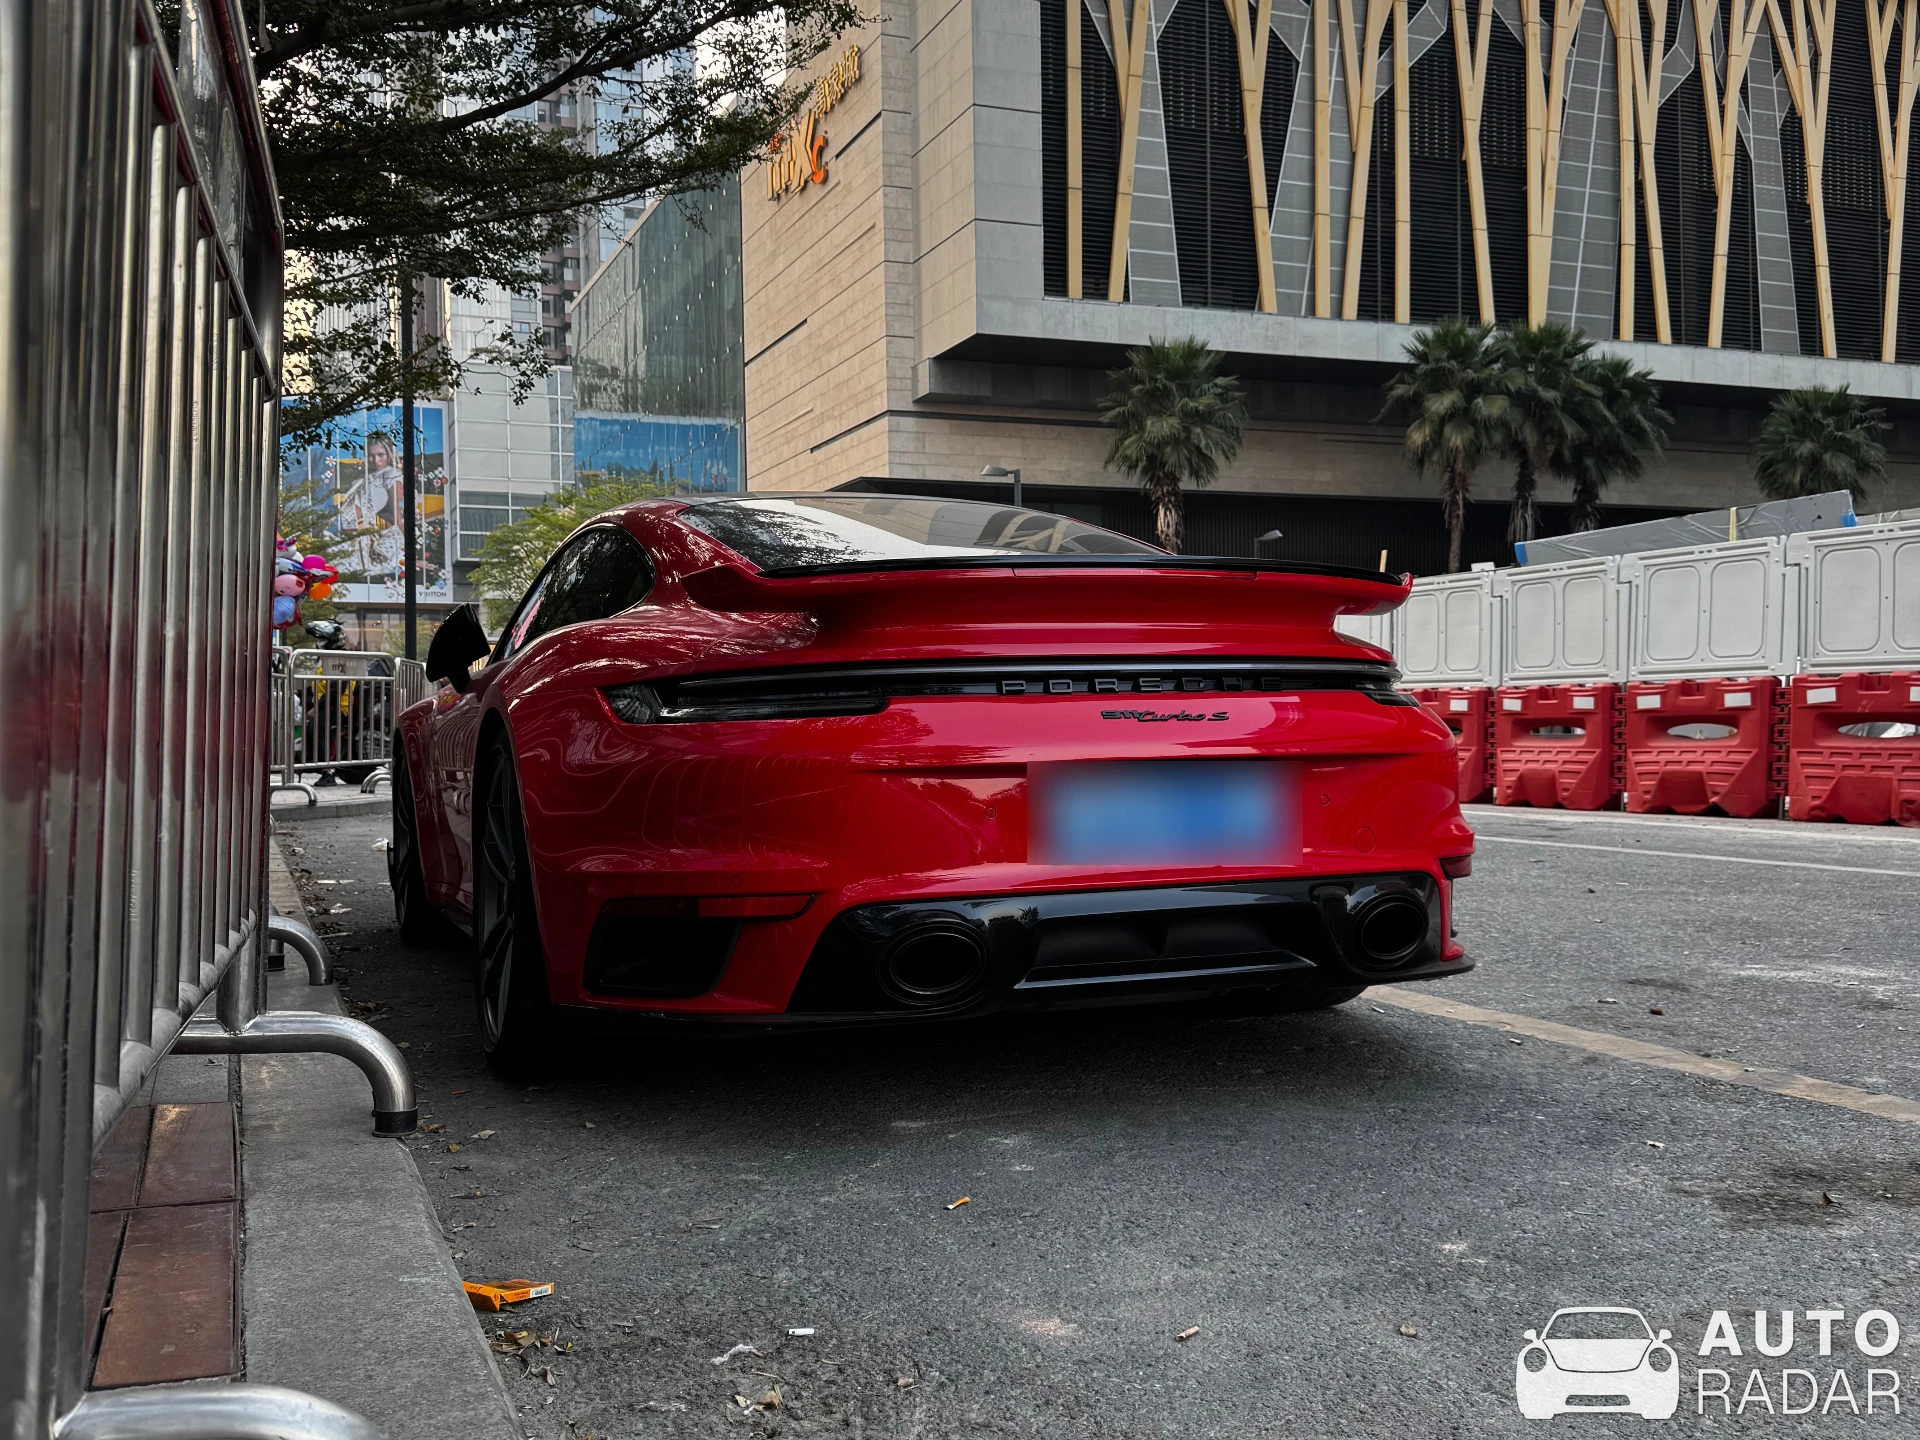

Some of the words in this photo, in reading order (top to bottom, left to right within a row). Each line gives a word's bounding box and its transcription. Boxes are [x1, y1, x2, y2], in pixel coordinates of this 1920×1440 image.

[999, 676, 1282, 694] PORSCHE
[1101, 710, 1140, 719] 911
[1207, 711, 1230, 721] S
